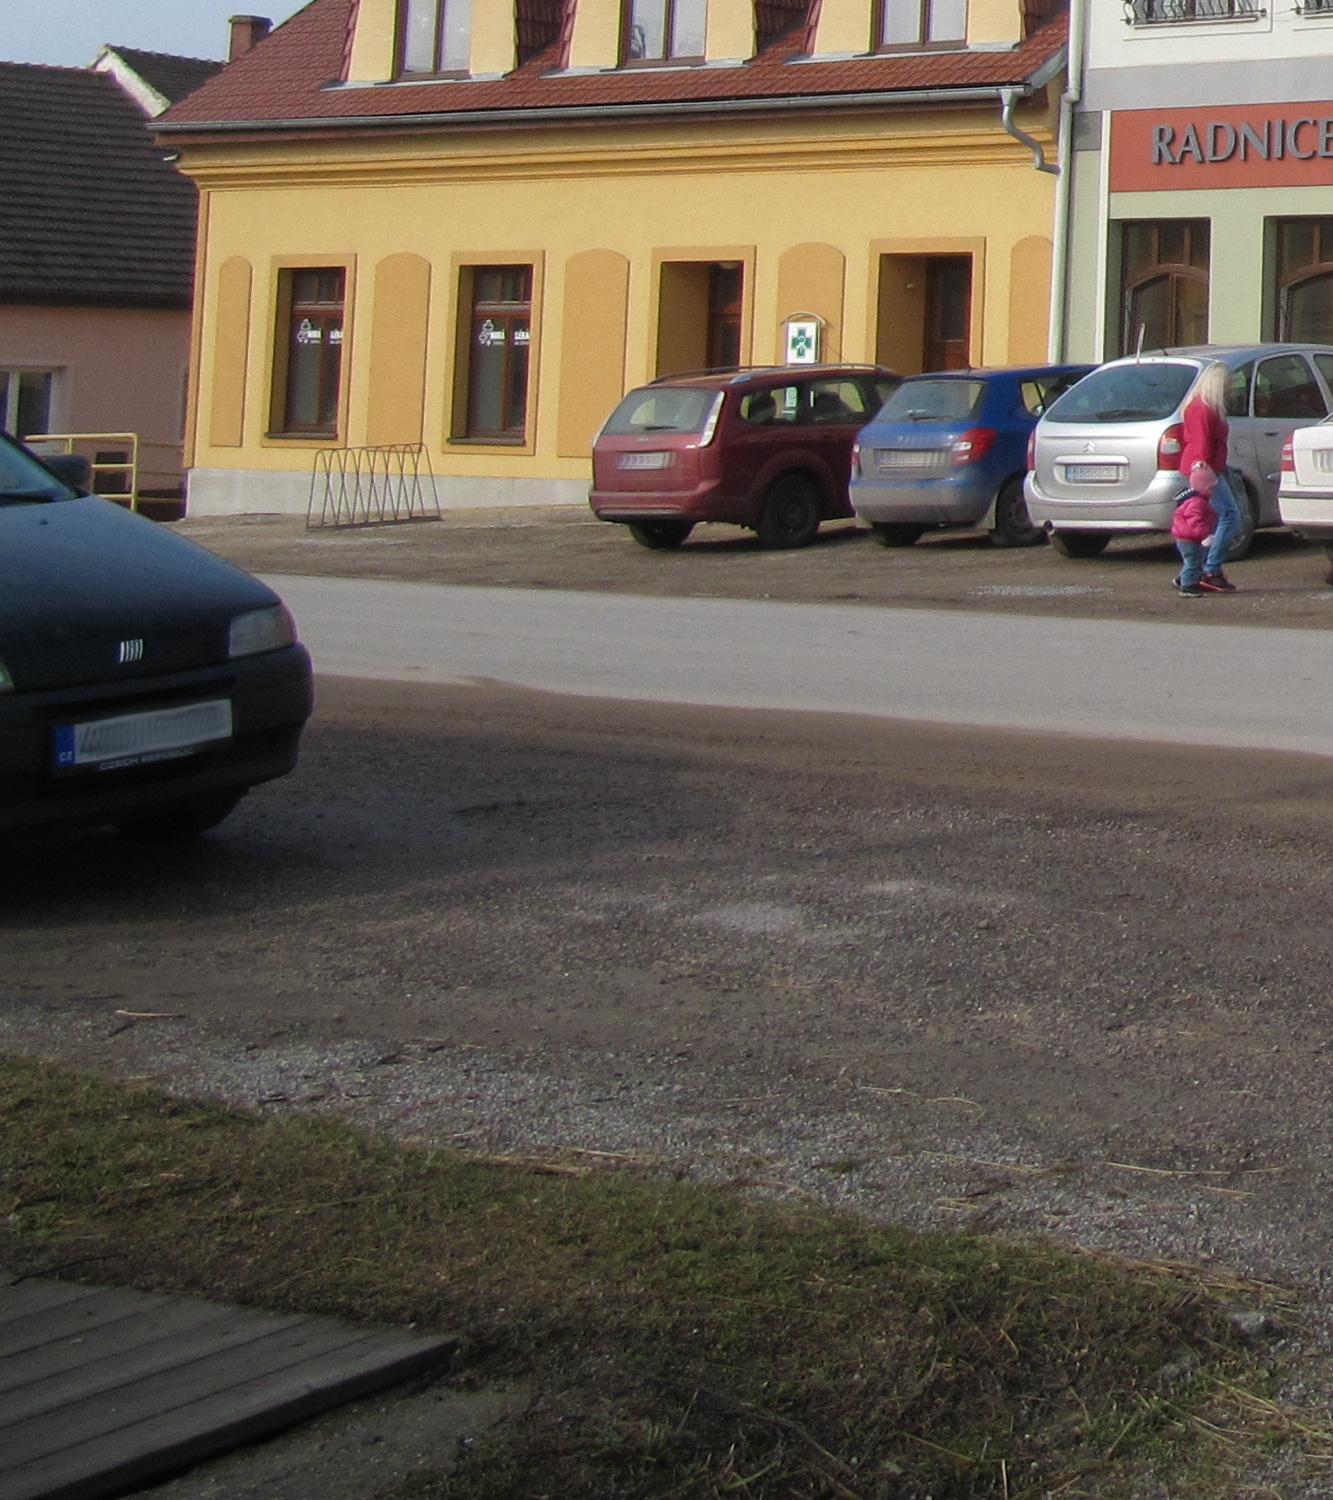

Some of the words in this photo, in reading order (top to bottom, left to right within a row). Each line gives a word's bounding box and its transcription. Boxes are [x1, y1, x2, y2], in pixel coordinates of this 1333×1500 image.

[59, 750, 74, 762] CZ
[100, 757, 139, 771] CZECH
[142, 747, 196, 764] REPUBLIC
